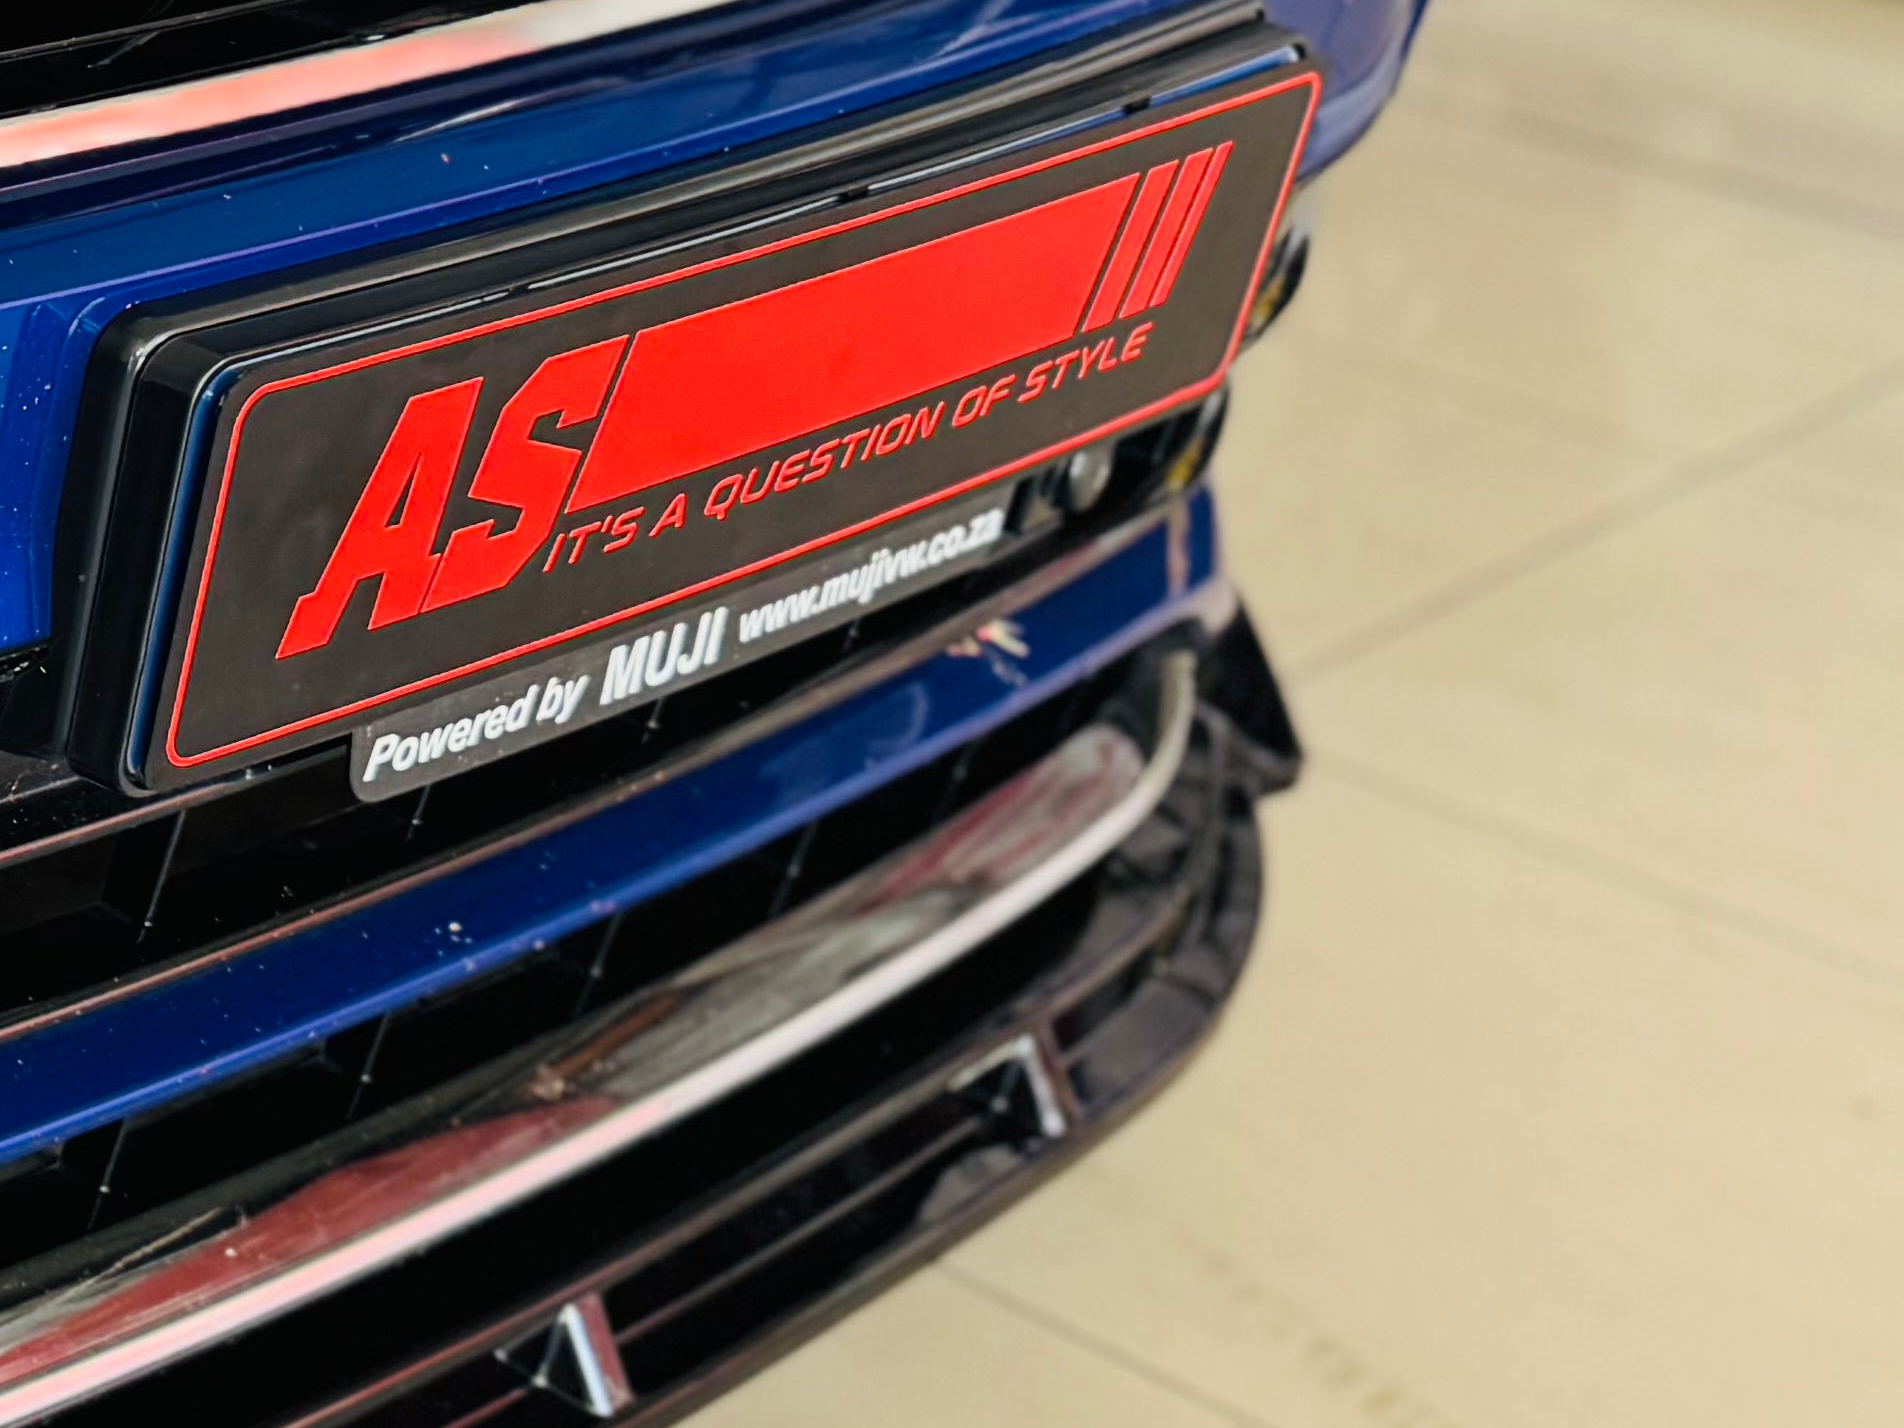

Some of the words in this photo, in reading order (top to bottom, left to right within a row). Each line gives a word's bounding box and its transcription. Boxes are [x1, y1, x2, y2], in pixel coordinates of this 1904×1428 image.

[275, 334, 630, 660] AS
[542, 506, 646, 573] IT'S
[648, 492, 688, 539] A
[702, 399, 945, 521] QUESTION
[951, 372, 1017, 430] OF
[1015, 321, 1154, 405] STYLE
[361, 682, 540, 783] Powered
[534, 671, 590, 725] by
[598, 605, 730, 707] MUJI
[738, 507, 1005, 644] www.mujivw.co.za
